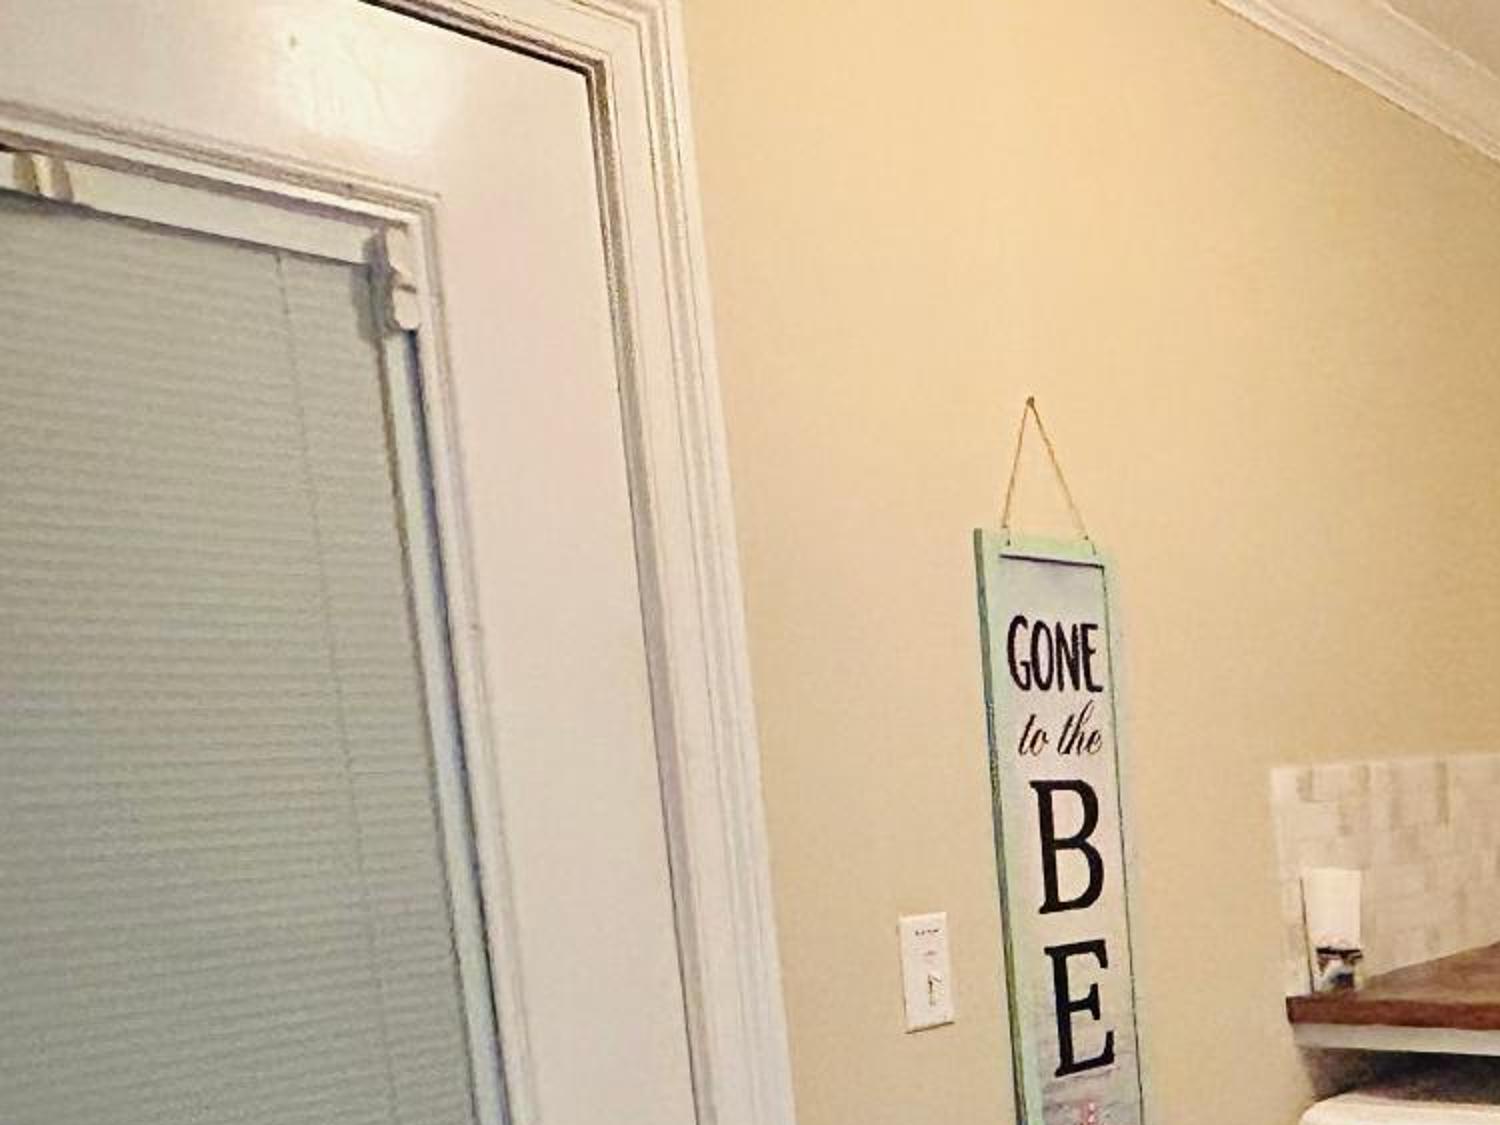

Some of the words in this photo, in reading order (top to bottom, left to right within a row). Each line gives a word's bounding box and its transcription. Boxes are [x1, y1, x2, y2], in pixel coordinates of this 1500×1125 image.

[1006, 614, 1104, 693] GONE
[1018, 713, 1049, 756] to
[1057, 699, 1102, 756] the
